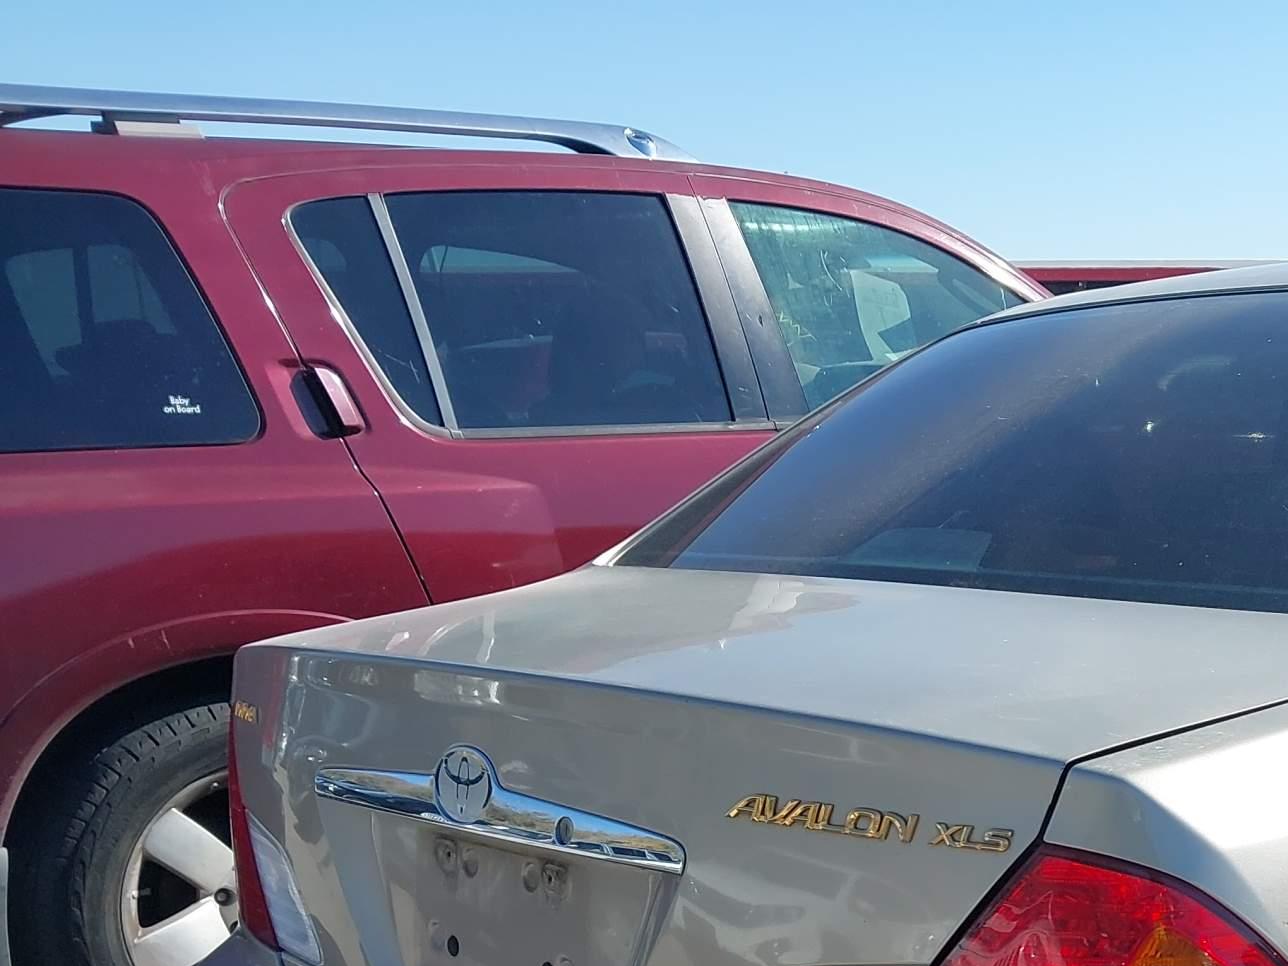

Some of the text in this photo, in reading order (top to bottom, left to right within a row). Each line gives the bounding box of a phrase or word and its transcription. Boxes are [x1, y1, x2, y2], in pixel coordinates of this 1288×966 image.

[169, 395, 190, 406] Baby
[164, 404, 201, 414] on Board
[724, 793, 1015, 853] AVALON XLS
